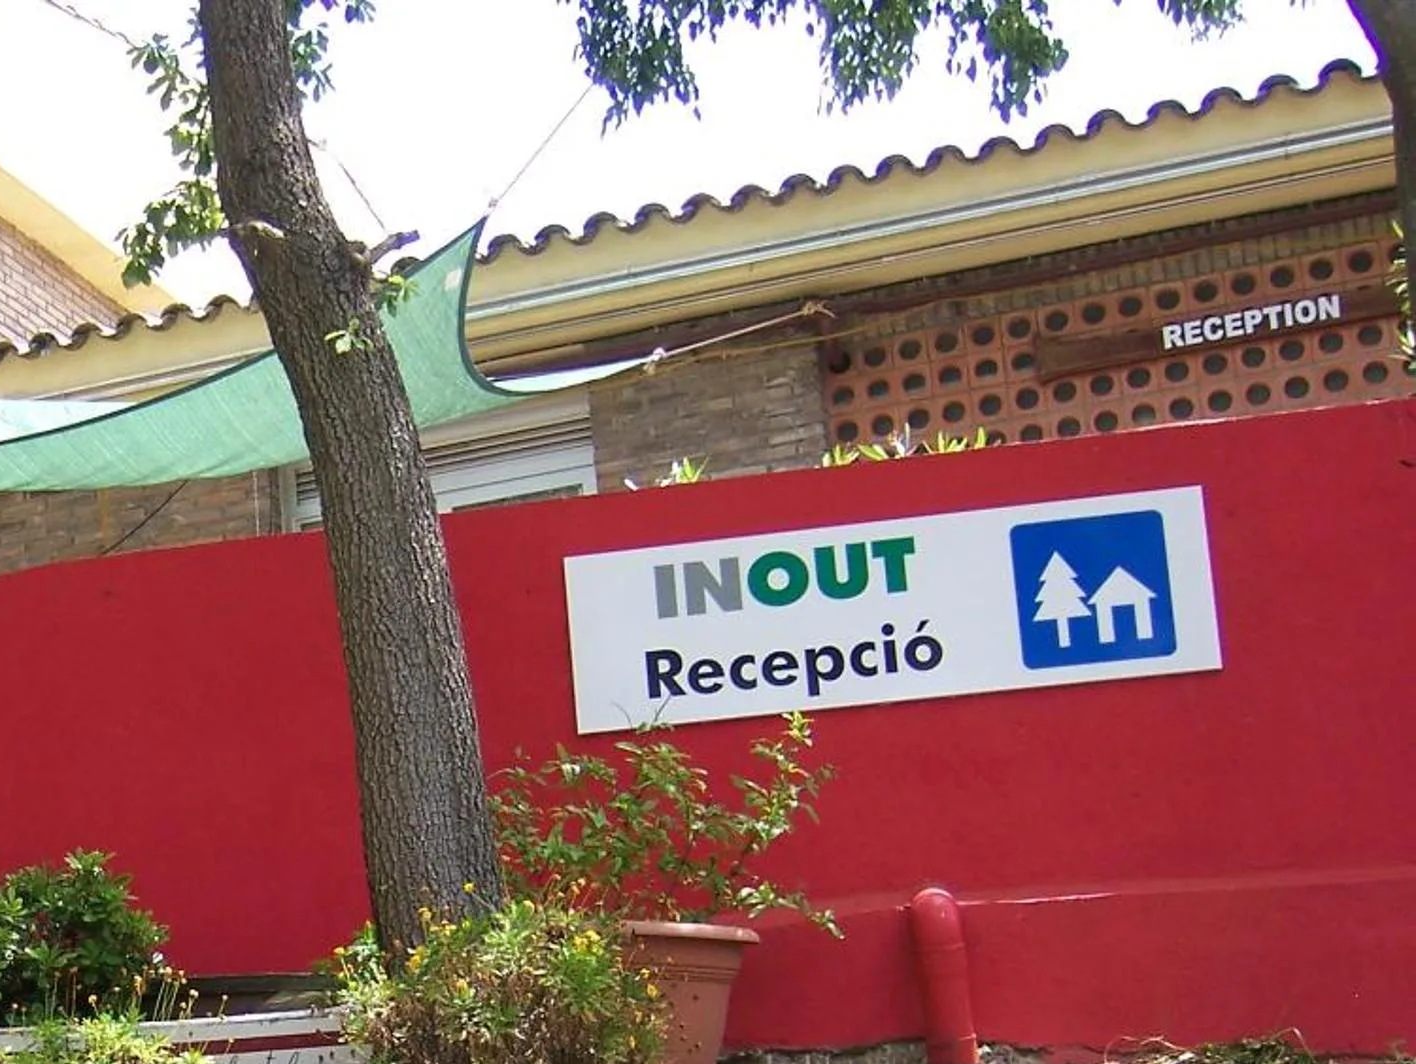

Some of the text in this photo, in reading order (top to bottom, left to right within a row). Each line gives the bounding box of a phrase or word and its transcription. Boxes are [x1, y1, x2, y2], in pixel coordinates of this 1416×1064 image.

[1162, 294, 1341, 350] RECEPTION
[652, 536, 915, 620] INOUT
[644, 619, 944, 699] Recepció
